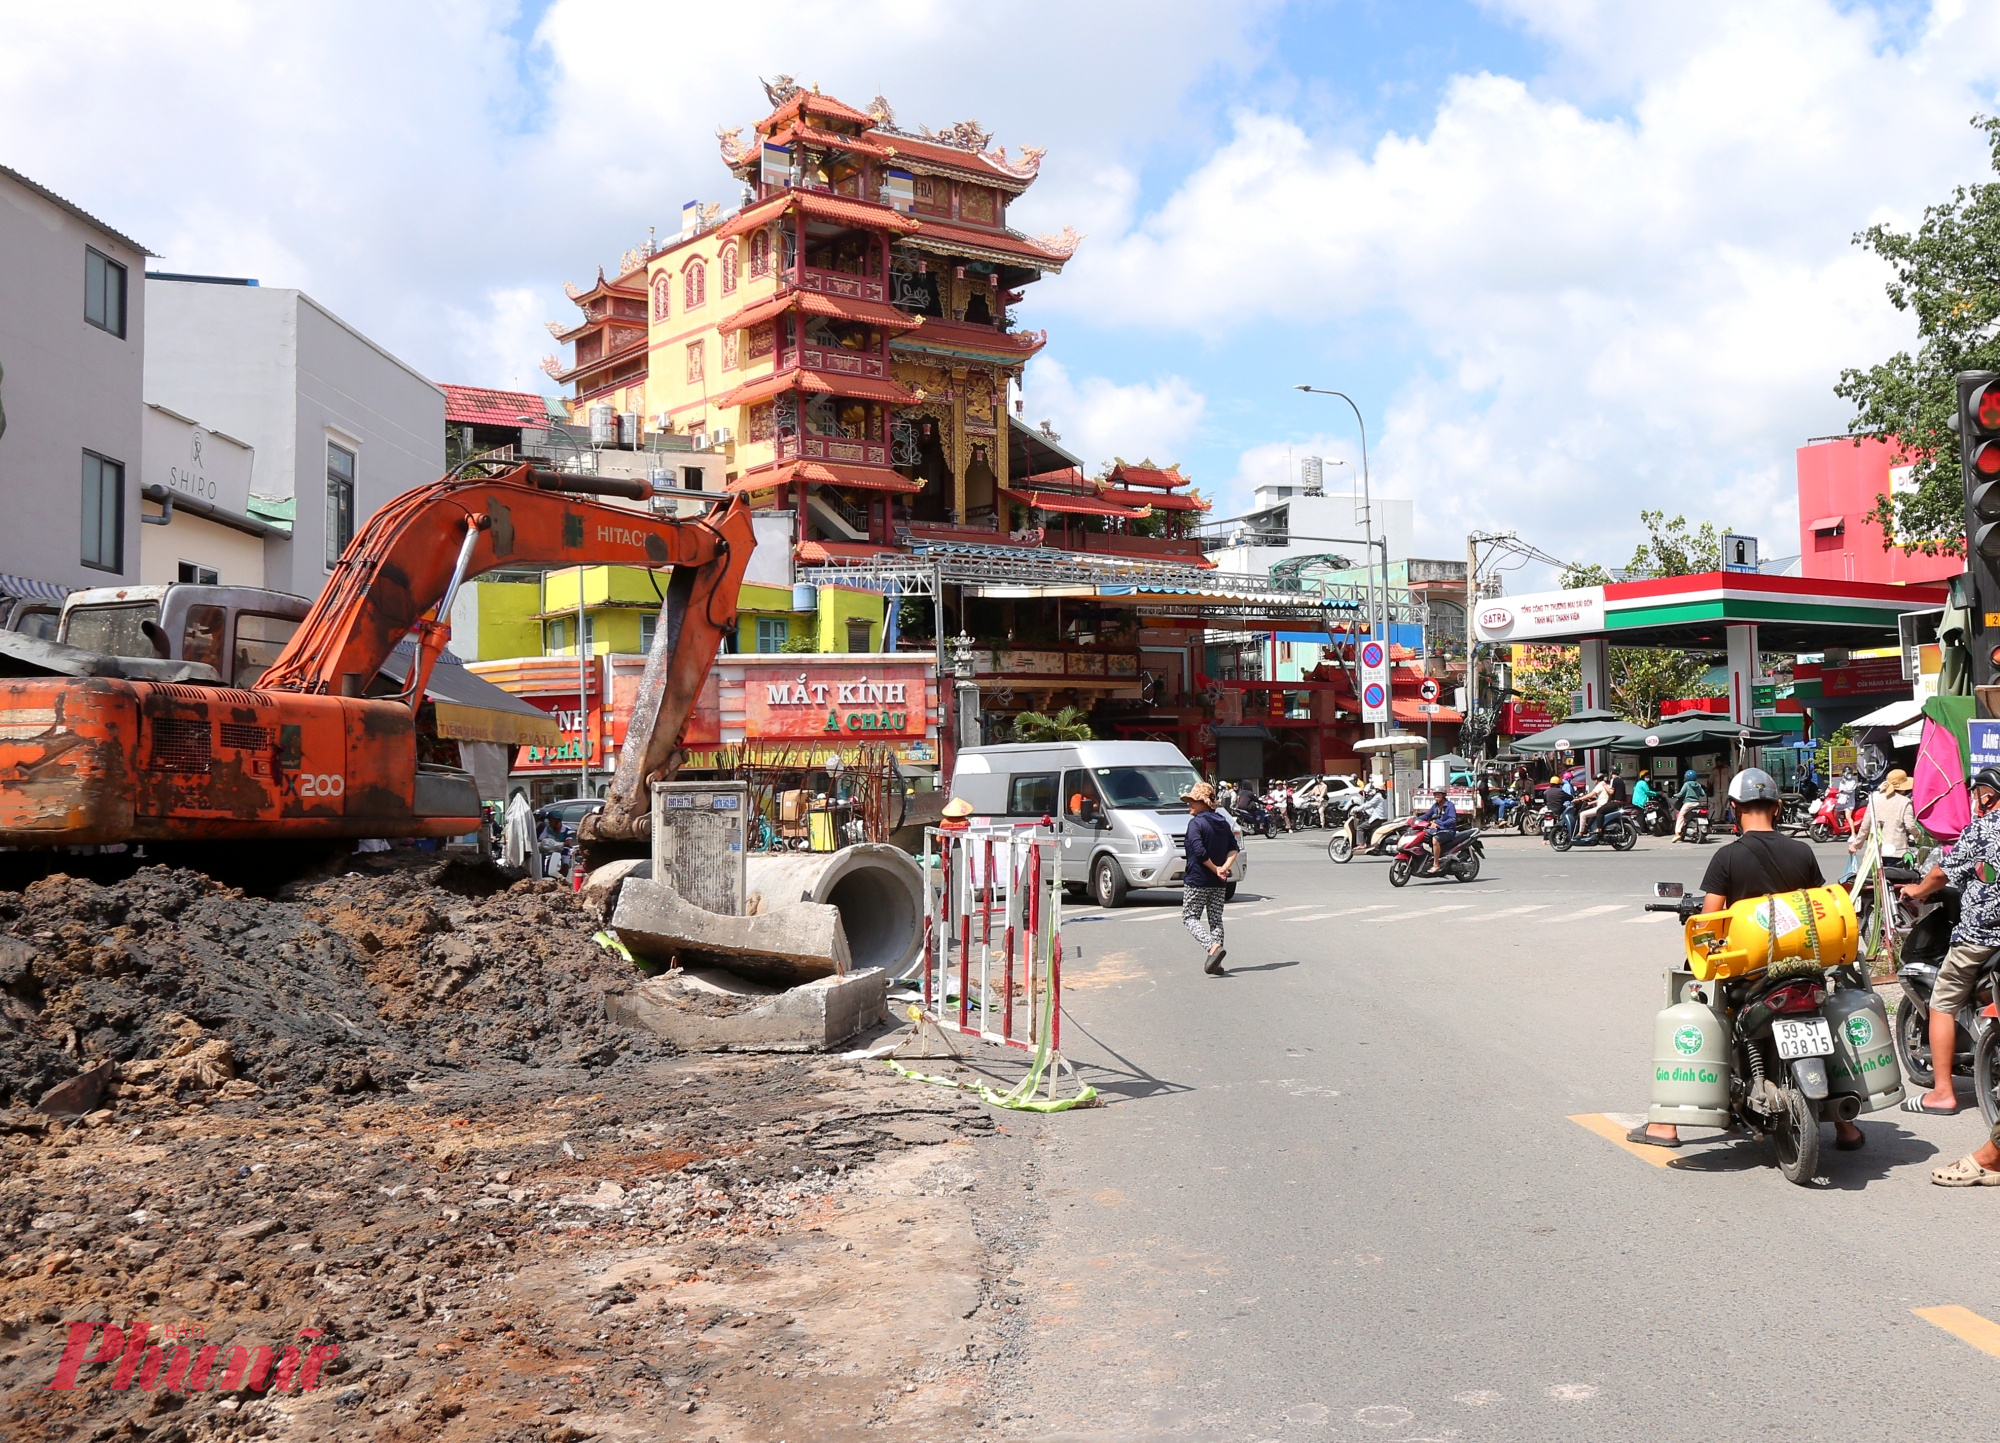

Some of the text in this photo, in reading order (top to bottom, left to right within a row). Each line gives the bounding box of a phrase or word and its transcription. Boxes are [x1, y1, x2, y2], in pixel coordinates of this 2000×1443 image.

[169, 466, 217, 500] SHIRO
[1483, 612, 1507, 625] SATRA
[767, 673, 905, 705] MẮT KÍNH
[823, 708, 906, 731] Á CHÂU
[1812, 900, 1826, 920] VIP
[1781, 1020, 1820, 1040] 59-S1
[1781, 1036, 1830, 1056] 038.15
[1656, 1066, 1670, 1081] Gia
[1698, 1068, 1718, 1084] Gas
